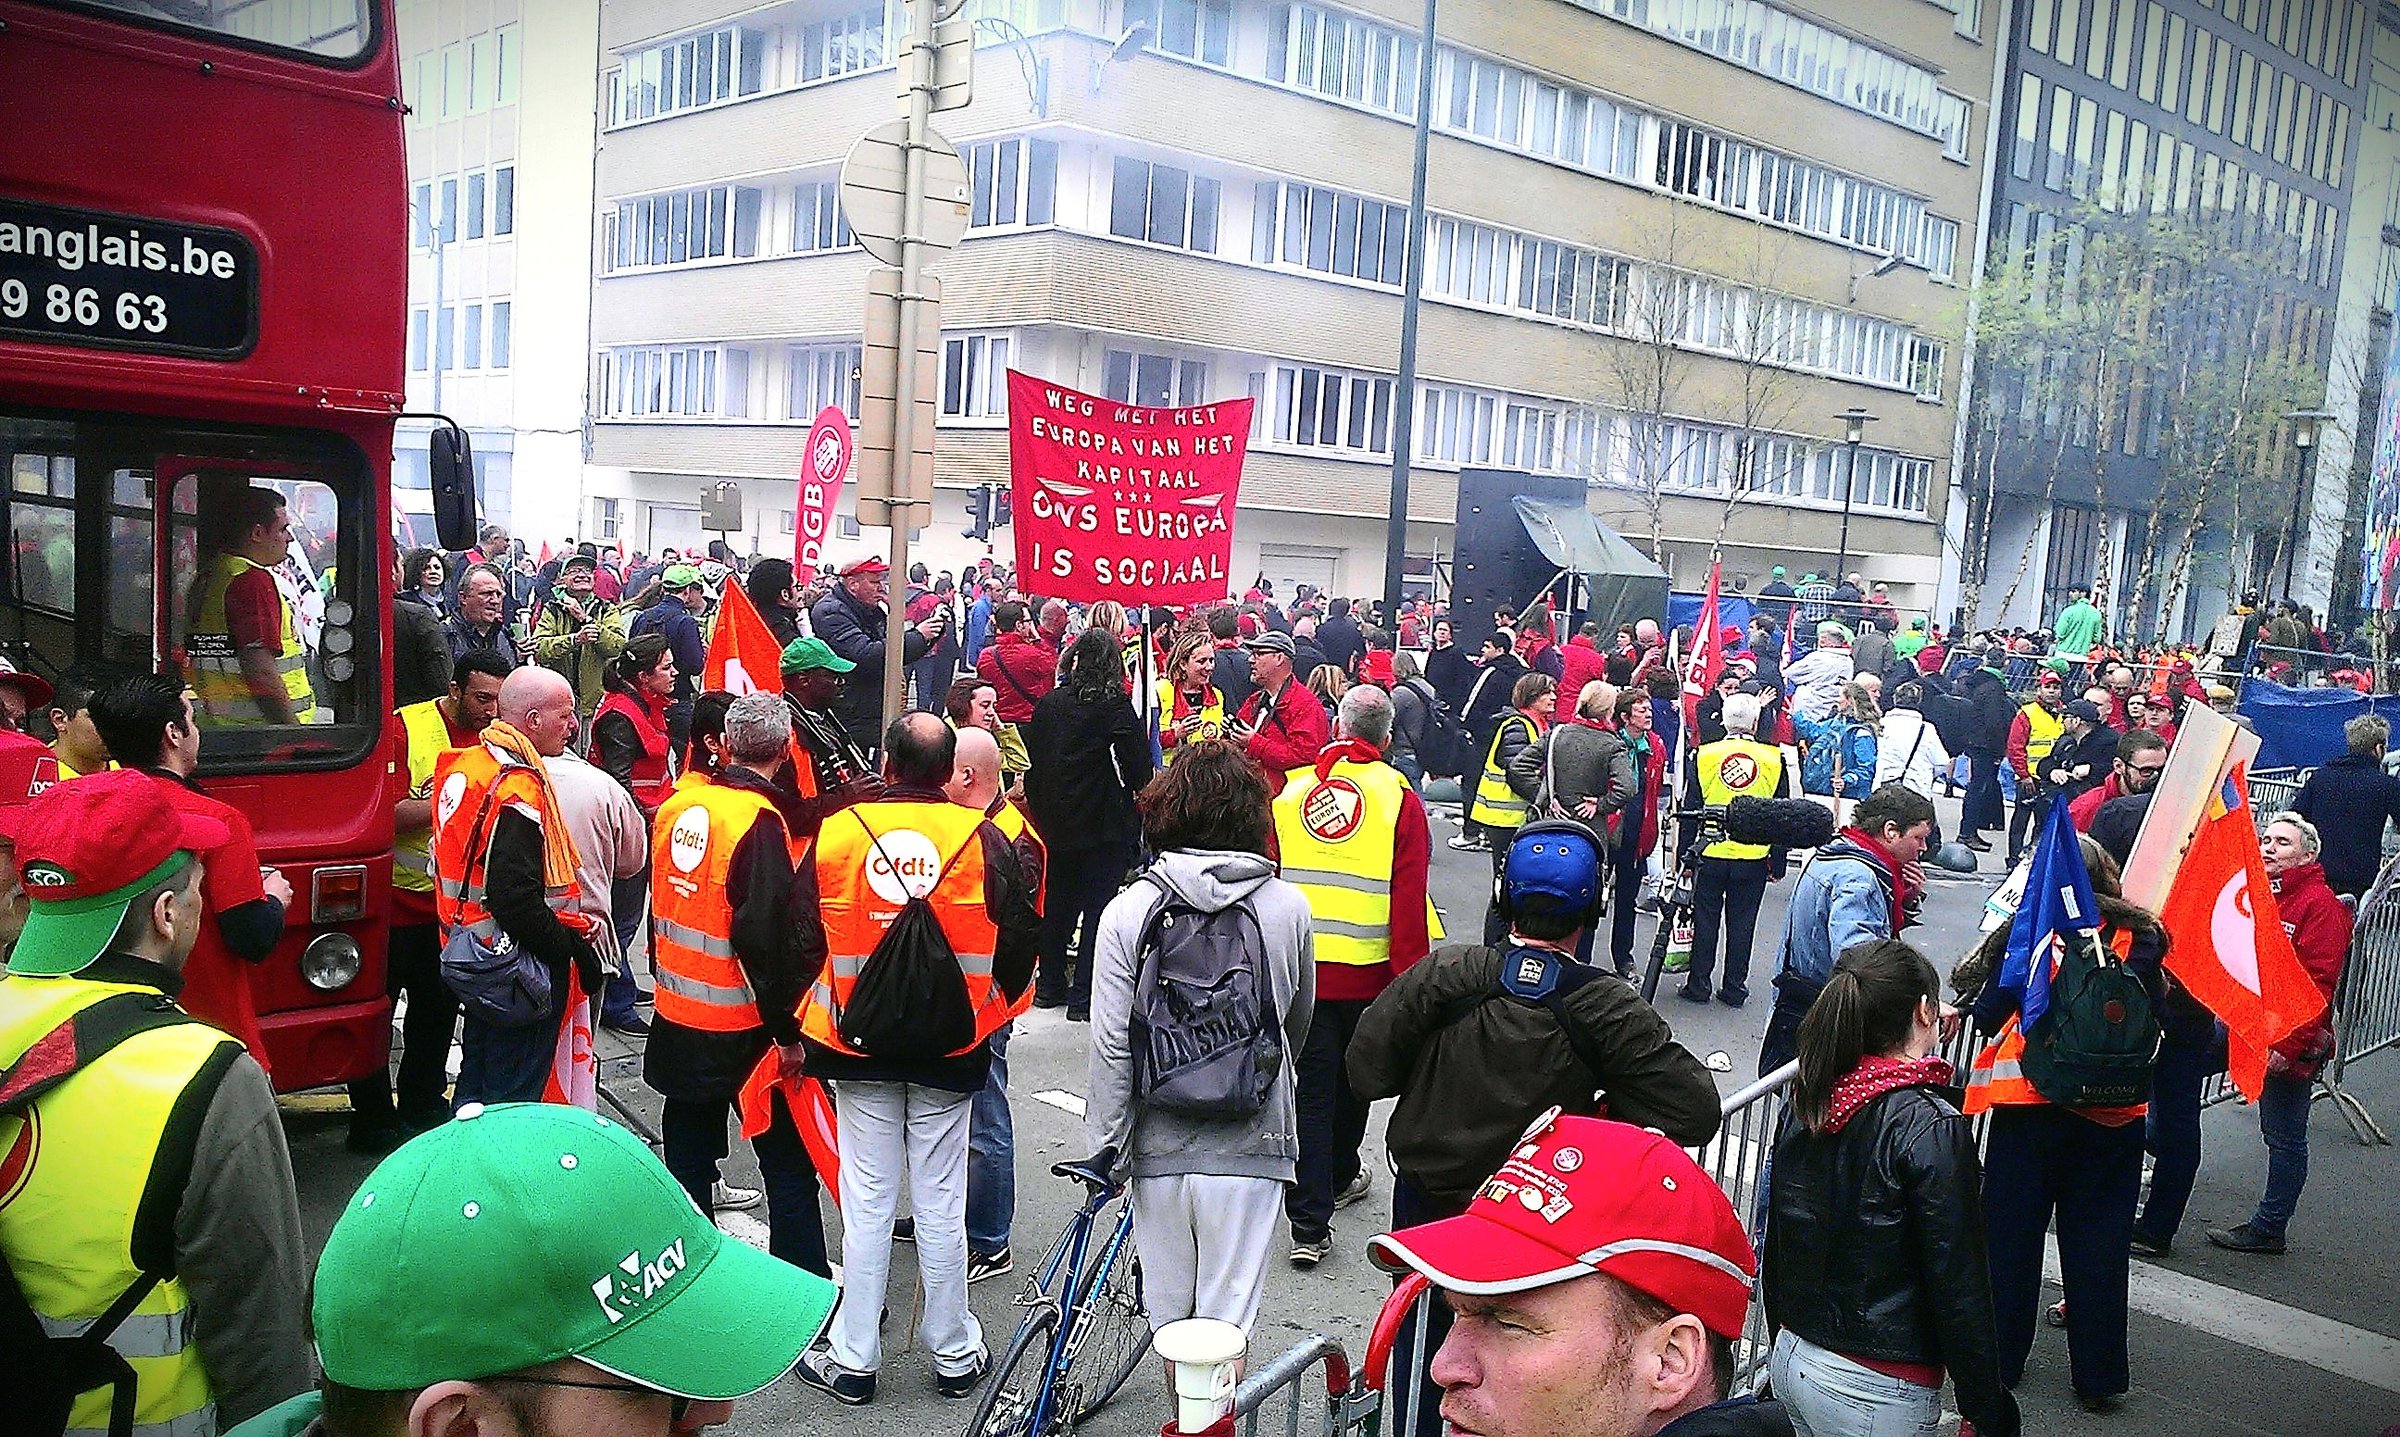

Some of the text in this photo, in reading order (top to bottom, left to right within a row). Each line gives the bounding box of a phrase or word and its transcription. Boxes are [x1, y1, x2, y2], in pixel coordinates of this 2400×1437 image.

[2, 279, 168, 333] 9 86 63
[1046, 389, 1217, 425] WEG MET HET
[1032, 417, 1234, 456] EUROPA VAN HET
[1078, 460, 1200, 488] KAPITAAL
[801, 482, 824, 567] DGB
[1032, 490, 1227, 539] ONS EUROPA
[1033, 542, 1225, 587] IS SOCIAAL
[873, 857, 934, 877] Cfdt:
[643, 1236, 687, 1300] ACV
